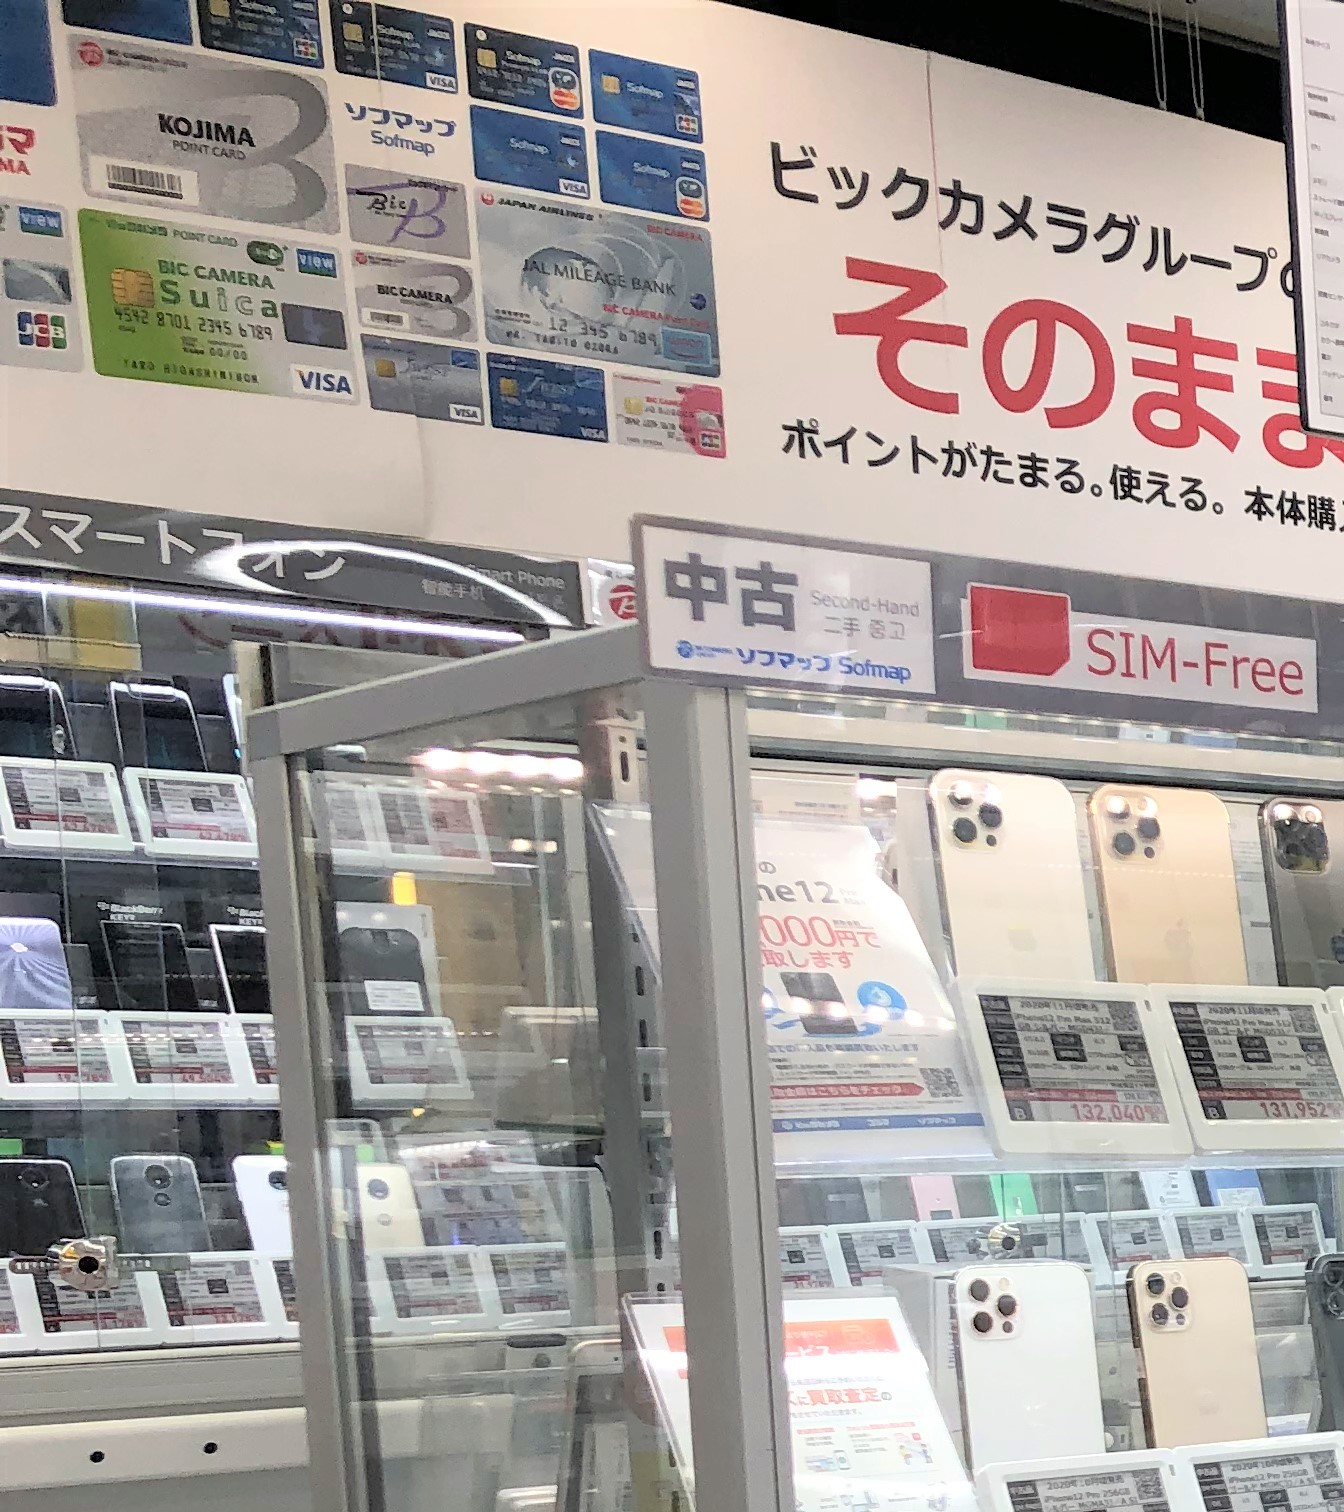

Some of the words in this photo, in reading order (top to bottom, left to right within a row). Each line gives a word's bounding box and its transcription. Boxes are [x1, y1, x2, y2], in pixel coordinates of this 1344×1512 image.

[157, 112, 256, 147] KOJIMA
[345, 102, 457, 137] ソフマップ
[173, 139, 208, 156] POINT
[211, 146, 247, 161] CARD
[371, 131, 435, 156] Sofmap
[158, 259, 190, 277] BIC
[193, 264, 275, 291] CAMERA
[522, 257, 550, 275] JAL
[553, 264, 627, 289] MILEAGE
[631, 276, 676, 297] BANK
[159, 279, 279, 319] Suica
[376, 284, 399, 298] BIC
[398, 286, 453, 305] CAMERA
[18, 311, 68, 349] JCB
[299, 370, 353, 395] VISA
[664, 552, 798, 632] 中古
[811, 590, 920, 617] Second-Hand
[839, 658, 912, 684] Sofmap
[1086, 628, 1306, 696] SIM-Free
